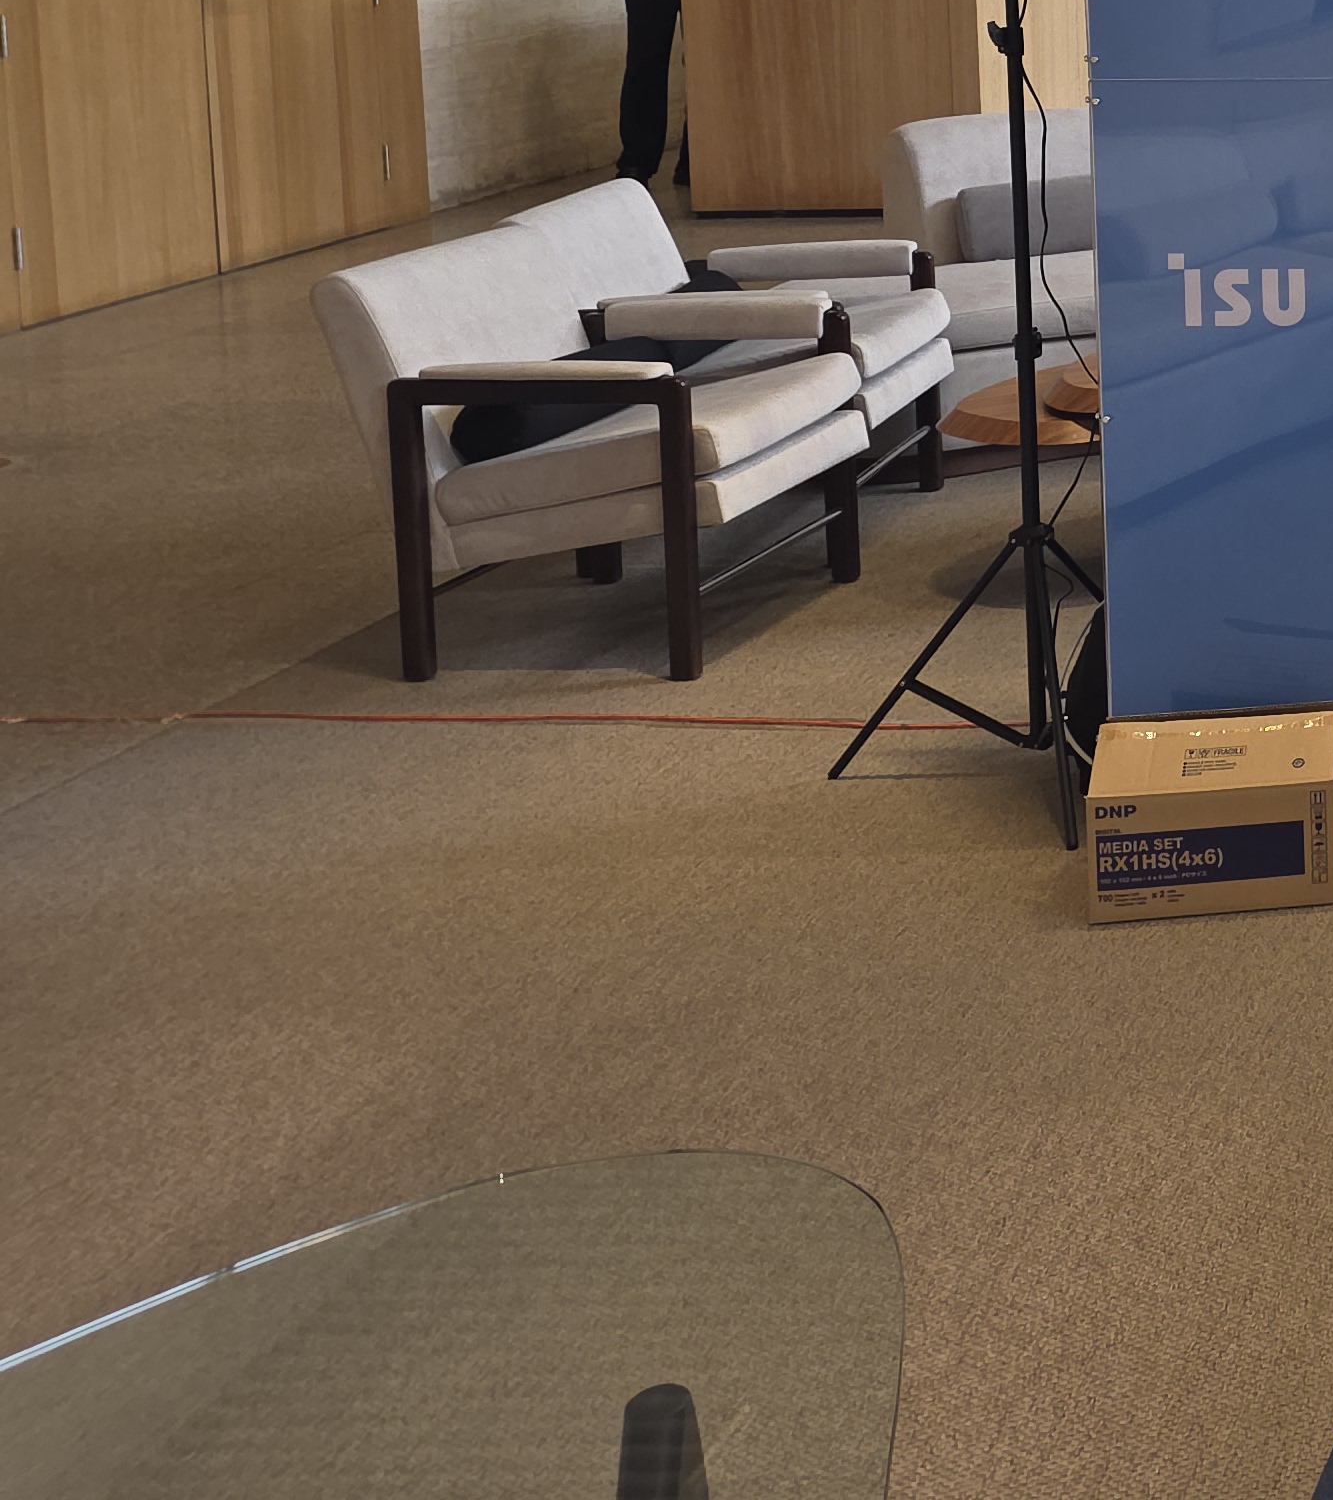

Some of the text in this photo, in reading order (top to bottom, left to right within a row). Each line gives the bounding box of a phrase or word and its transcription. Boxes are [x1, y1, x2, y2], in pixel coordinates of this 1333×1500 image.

[1094, 804, 1137, 820] DNP
[1099, 836, 1184, 855] MEDIA SET
[1099, 847, 1224, 873] RX1HS(4x6)
